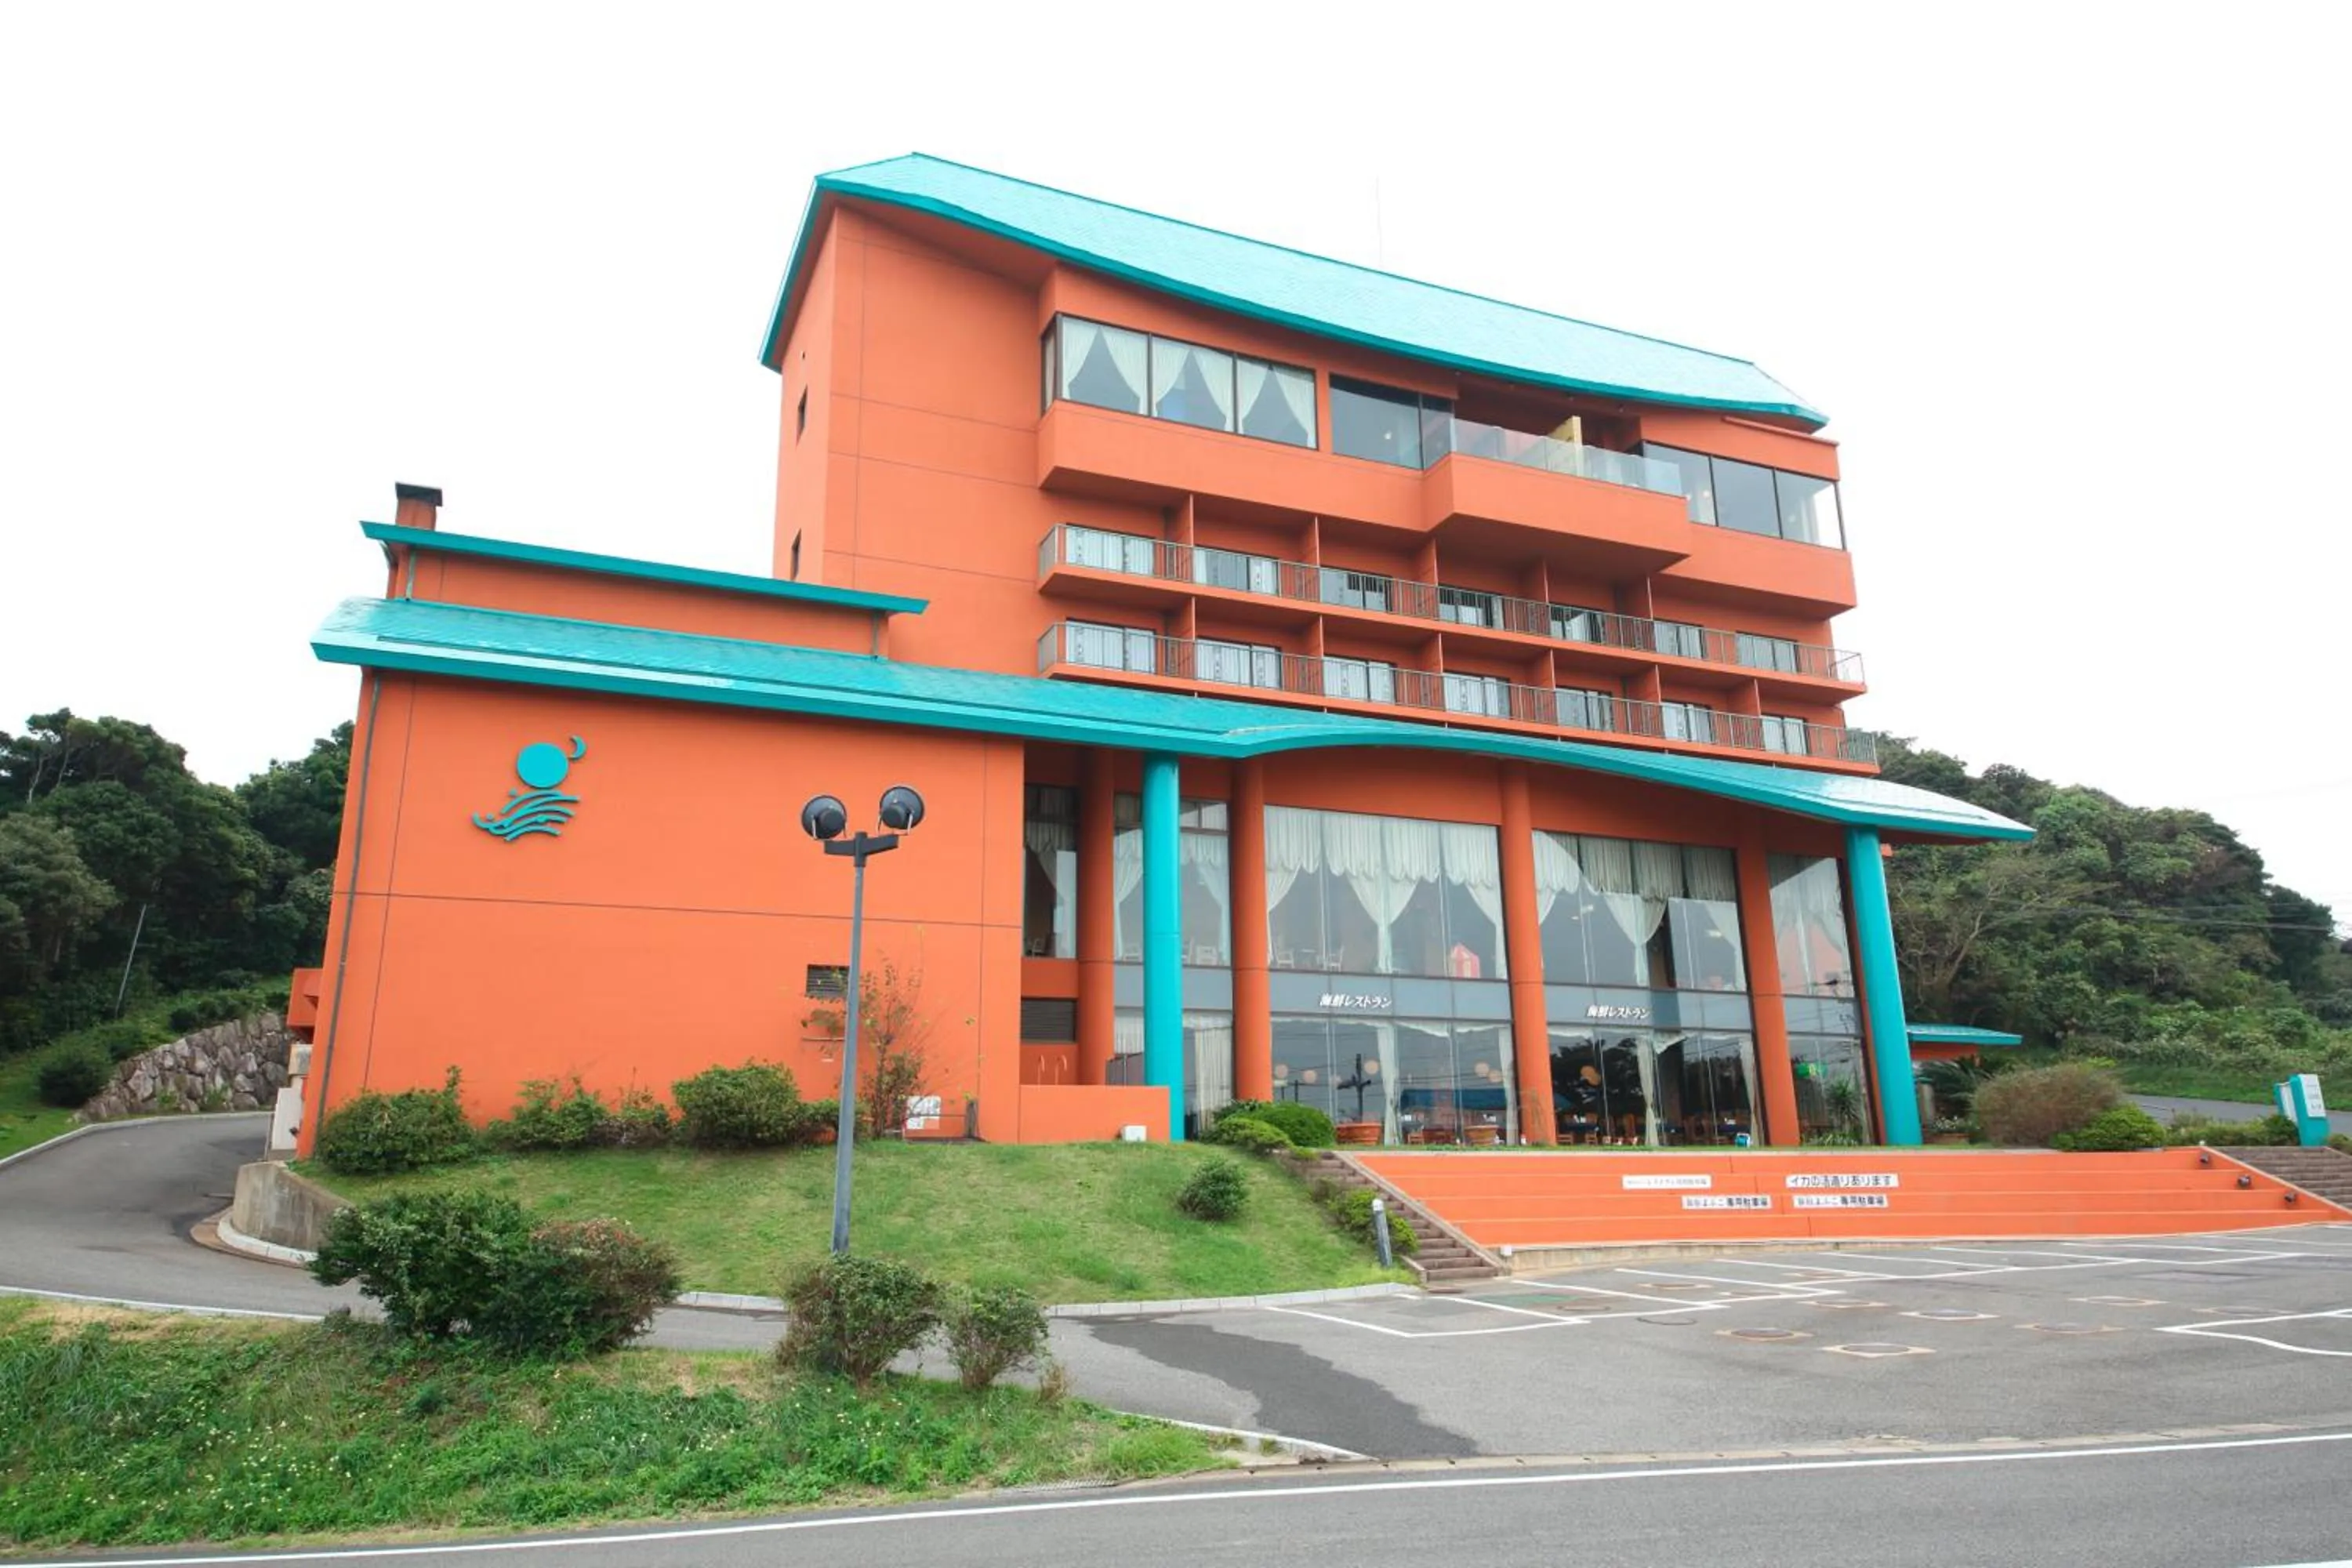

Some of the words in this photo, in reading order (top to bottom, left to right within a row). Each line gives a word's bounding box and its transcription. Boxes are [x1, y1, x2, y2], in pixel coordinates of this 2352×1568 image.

[1319, 993, 1392, 1009] 海鮮レストラン
